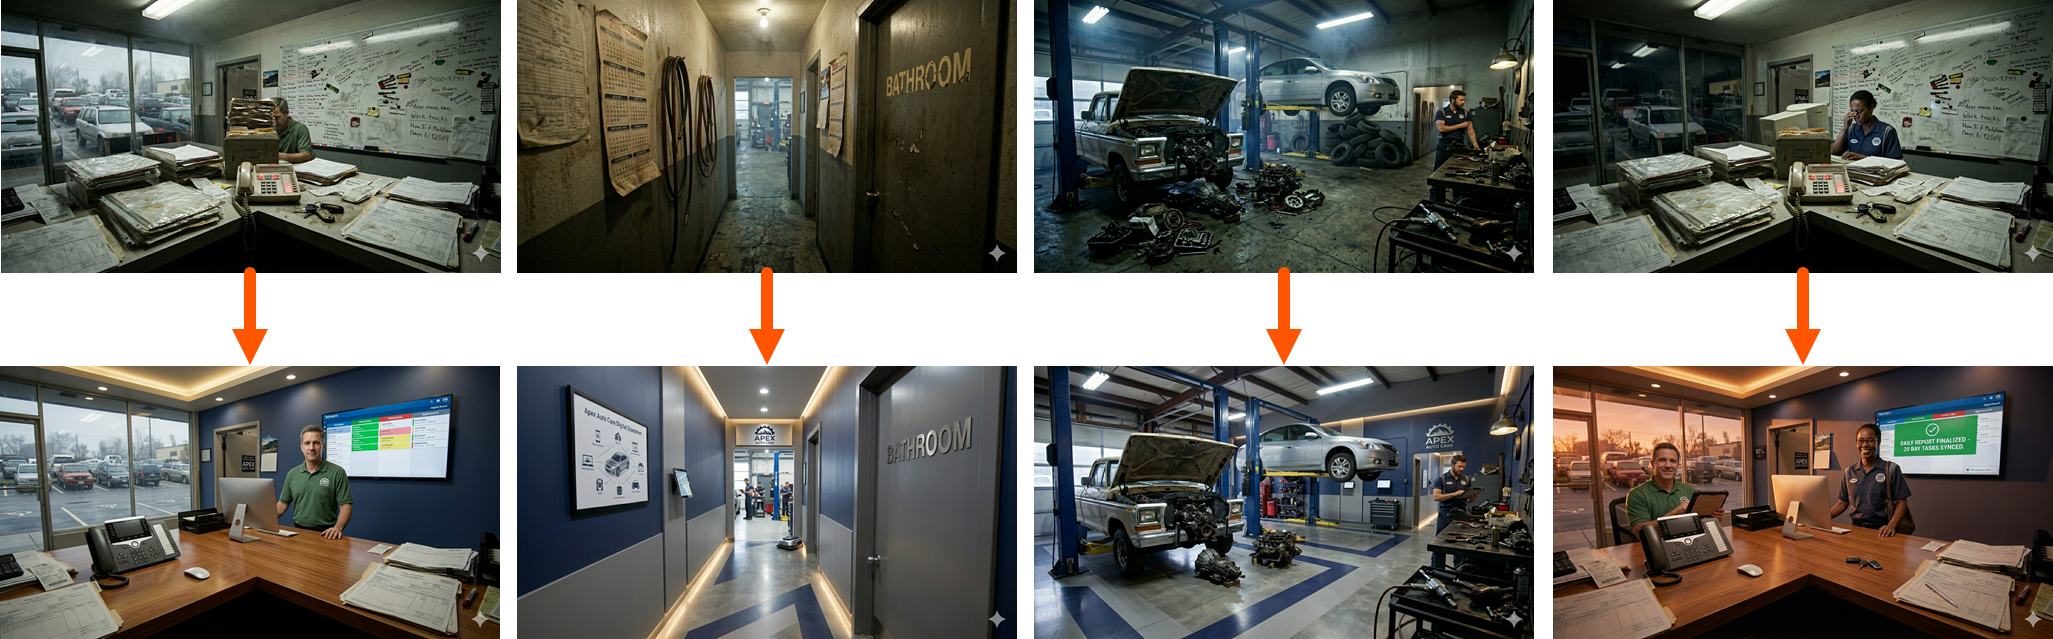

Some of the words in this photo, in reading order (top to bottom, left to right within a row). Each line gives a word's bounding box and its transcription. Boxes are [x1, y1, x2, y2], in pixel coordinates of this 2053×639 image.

[886, 47, 972, 97] BATHROOM
[429, 114, 448, 122] tracks
[1981, 114, 2000, 122] tracks
[584, 408, 596, 417] Apex
[597, 413, 606, 422] Auto
[607, 417, 615, 425] Care
[887, 416, 972, 464] BATHROOM
[1425, 436, 1454, 445] APEX
